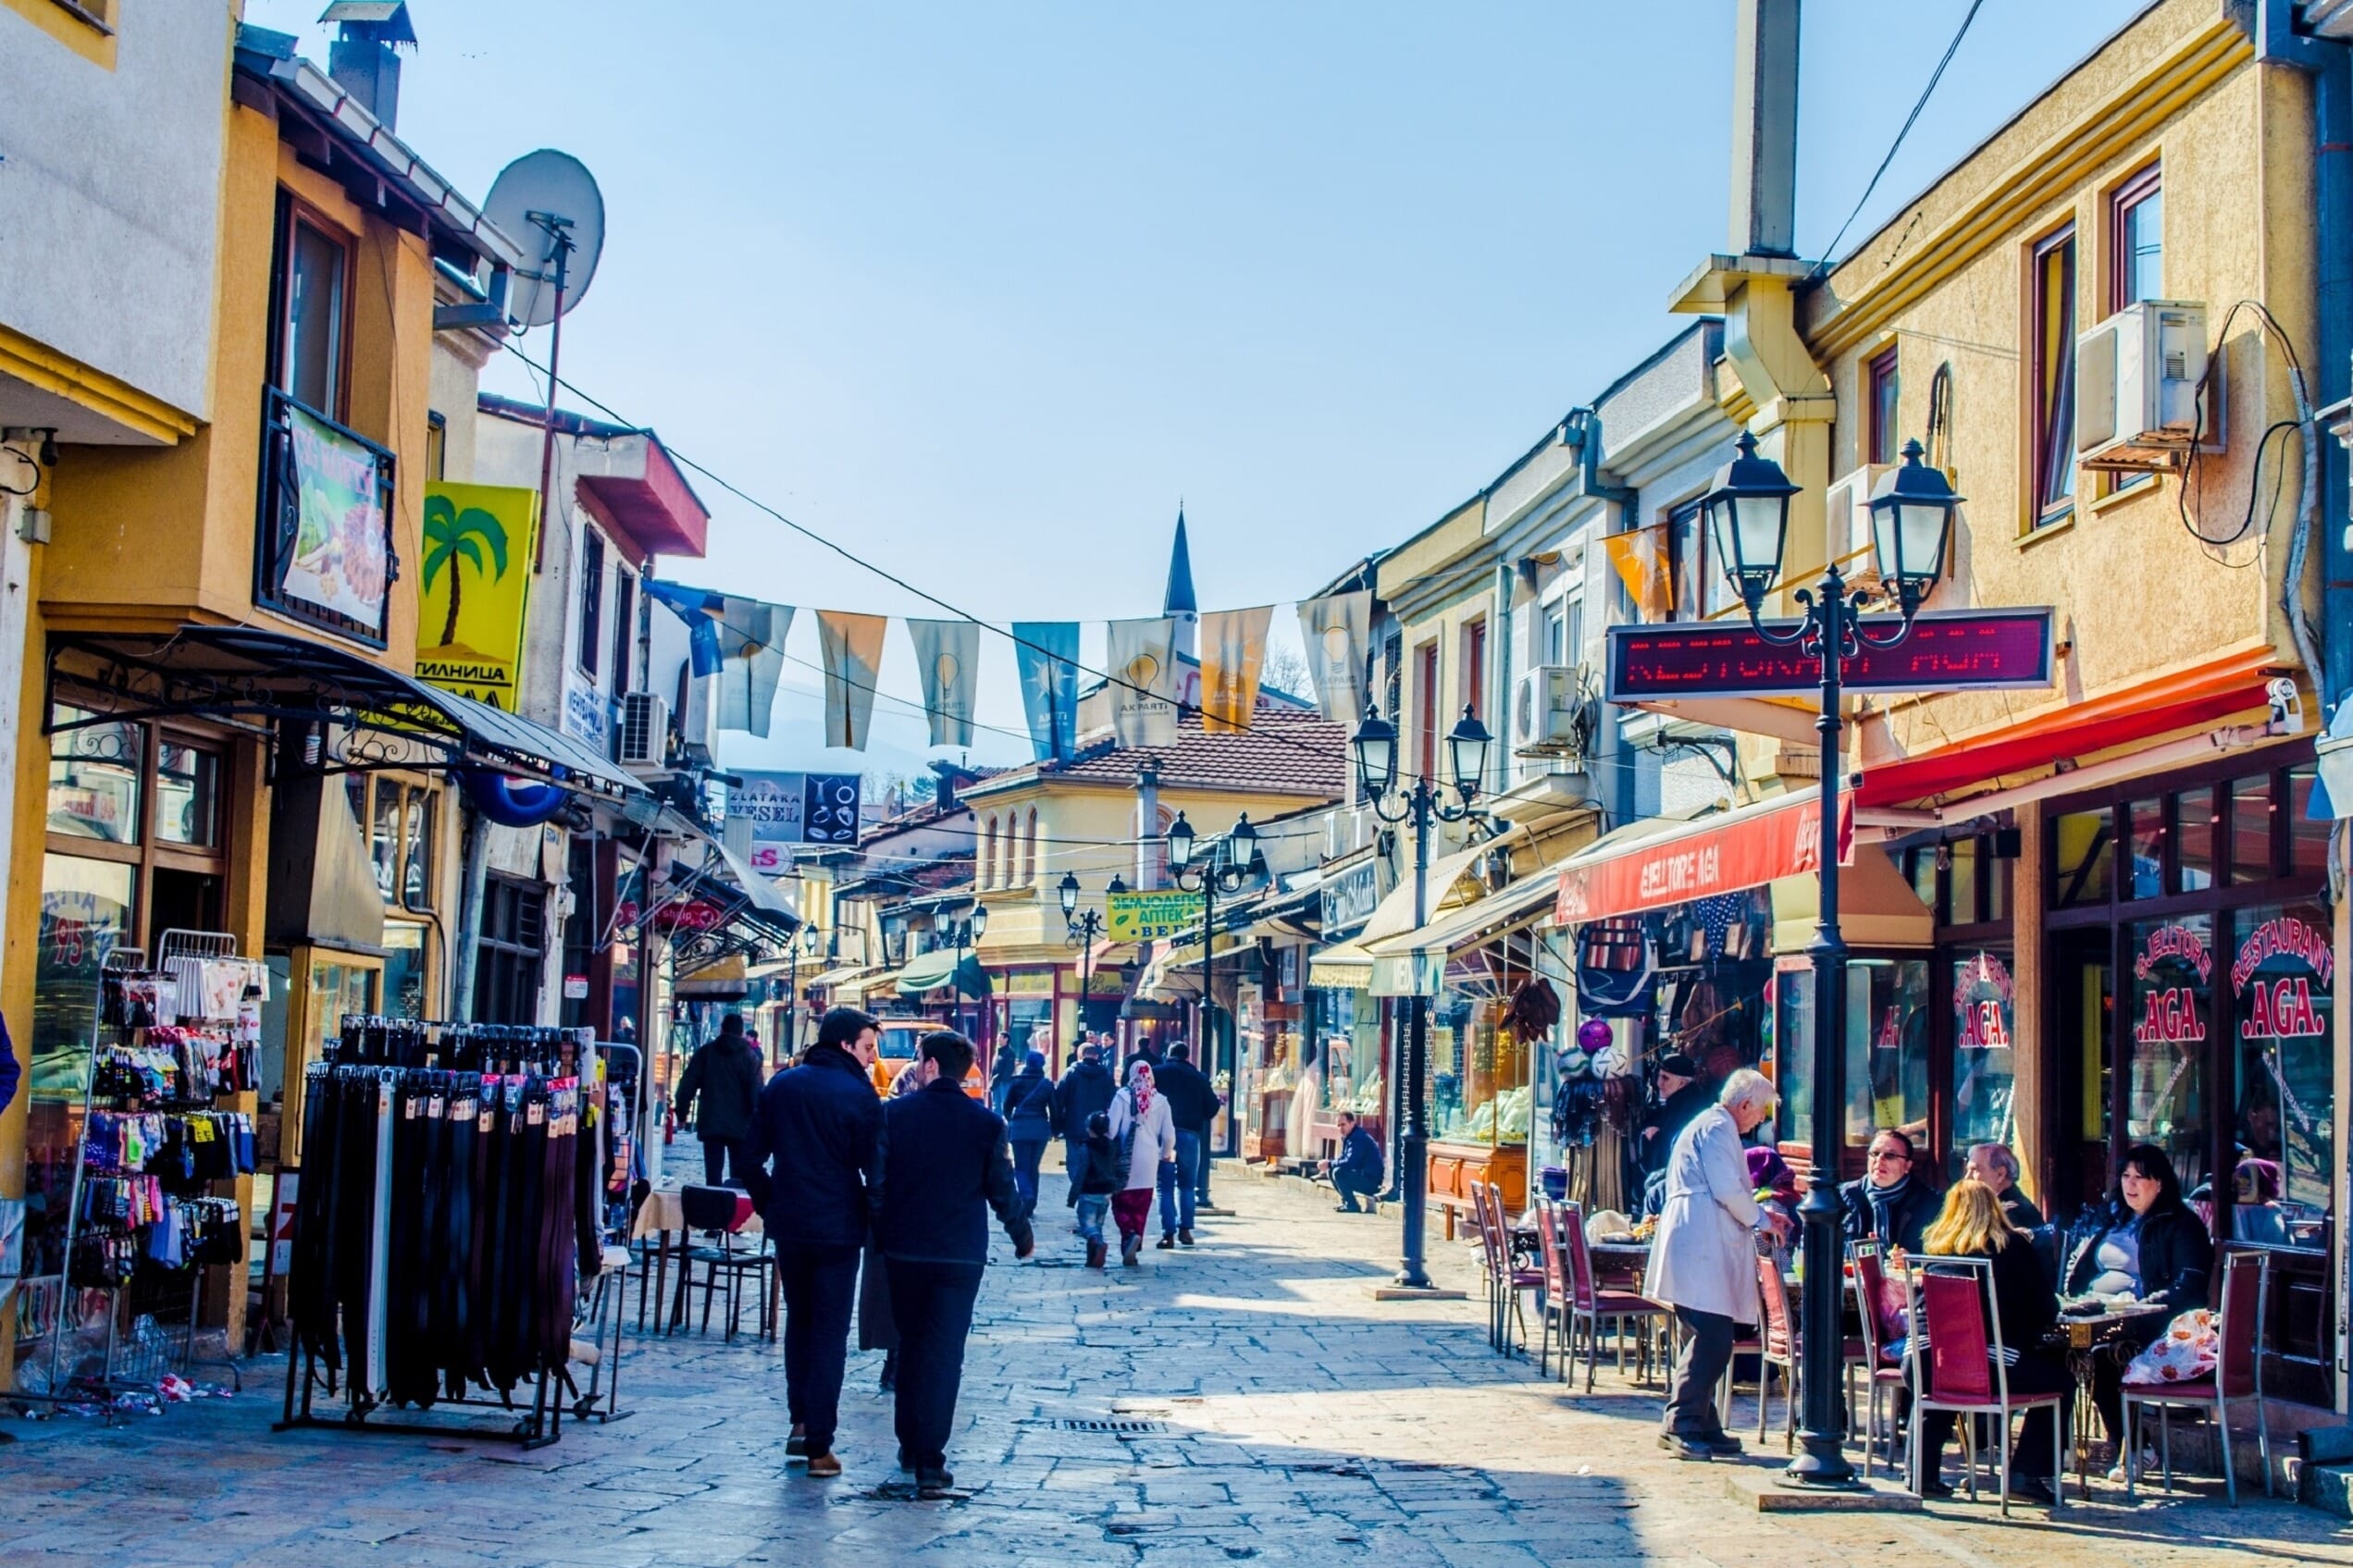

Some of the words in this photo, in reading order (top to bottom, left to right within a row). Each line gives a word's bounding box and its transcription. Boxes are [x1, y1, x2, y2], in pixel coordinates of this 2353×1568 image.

[730, 791, 800, 804] ZLATARA
[730, 805, 800, 822] VESEL
[55, 917, 84, 967] 95
[2136, 925, 2212, 985] GJELLTORE
[2230, 918, 2334, 999] RESTAURANT
